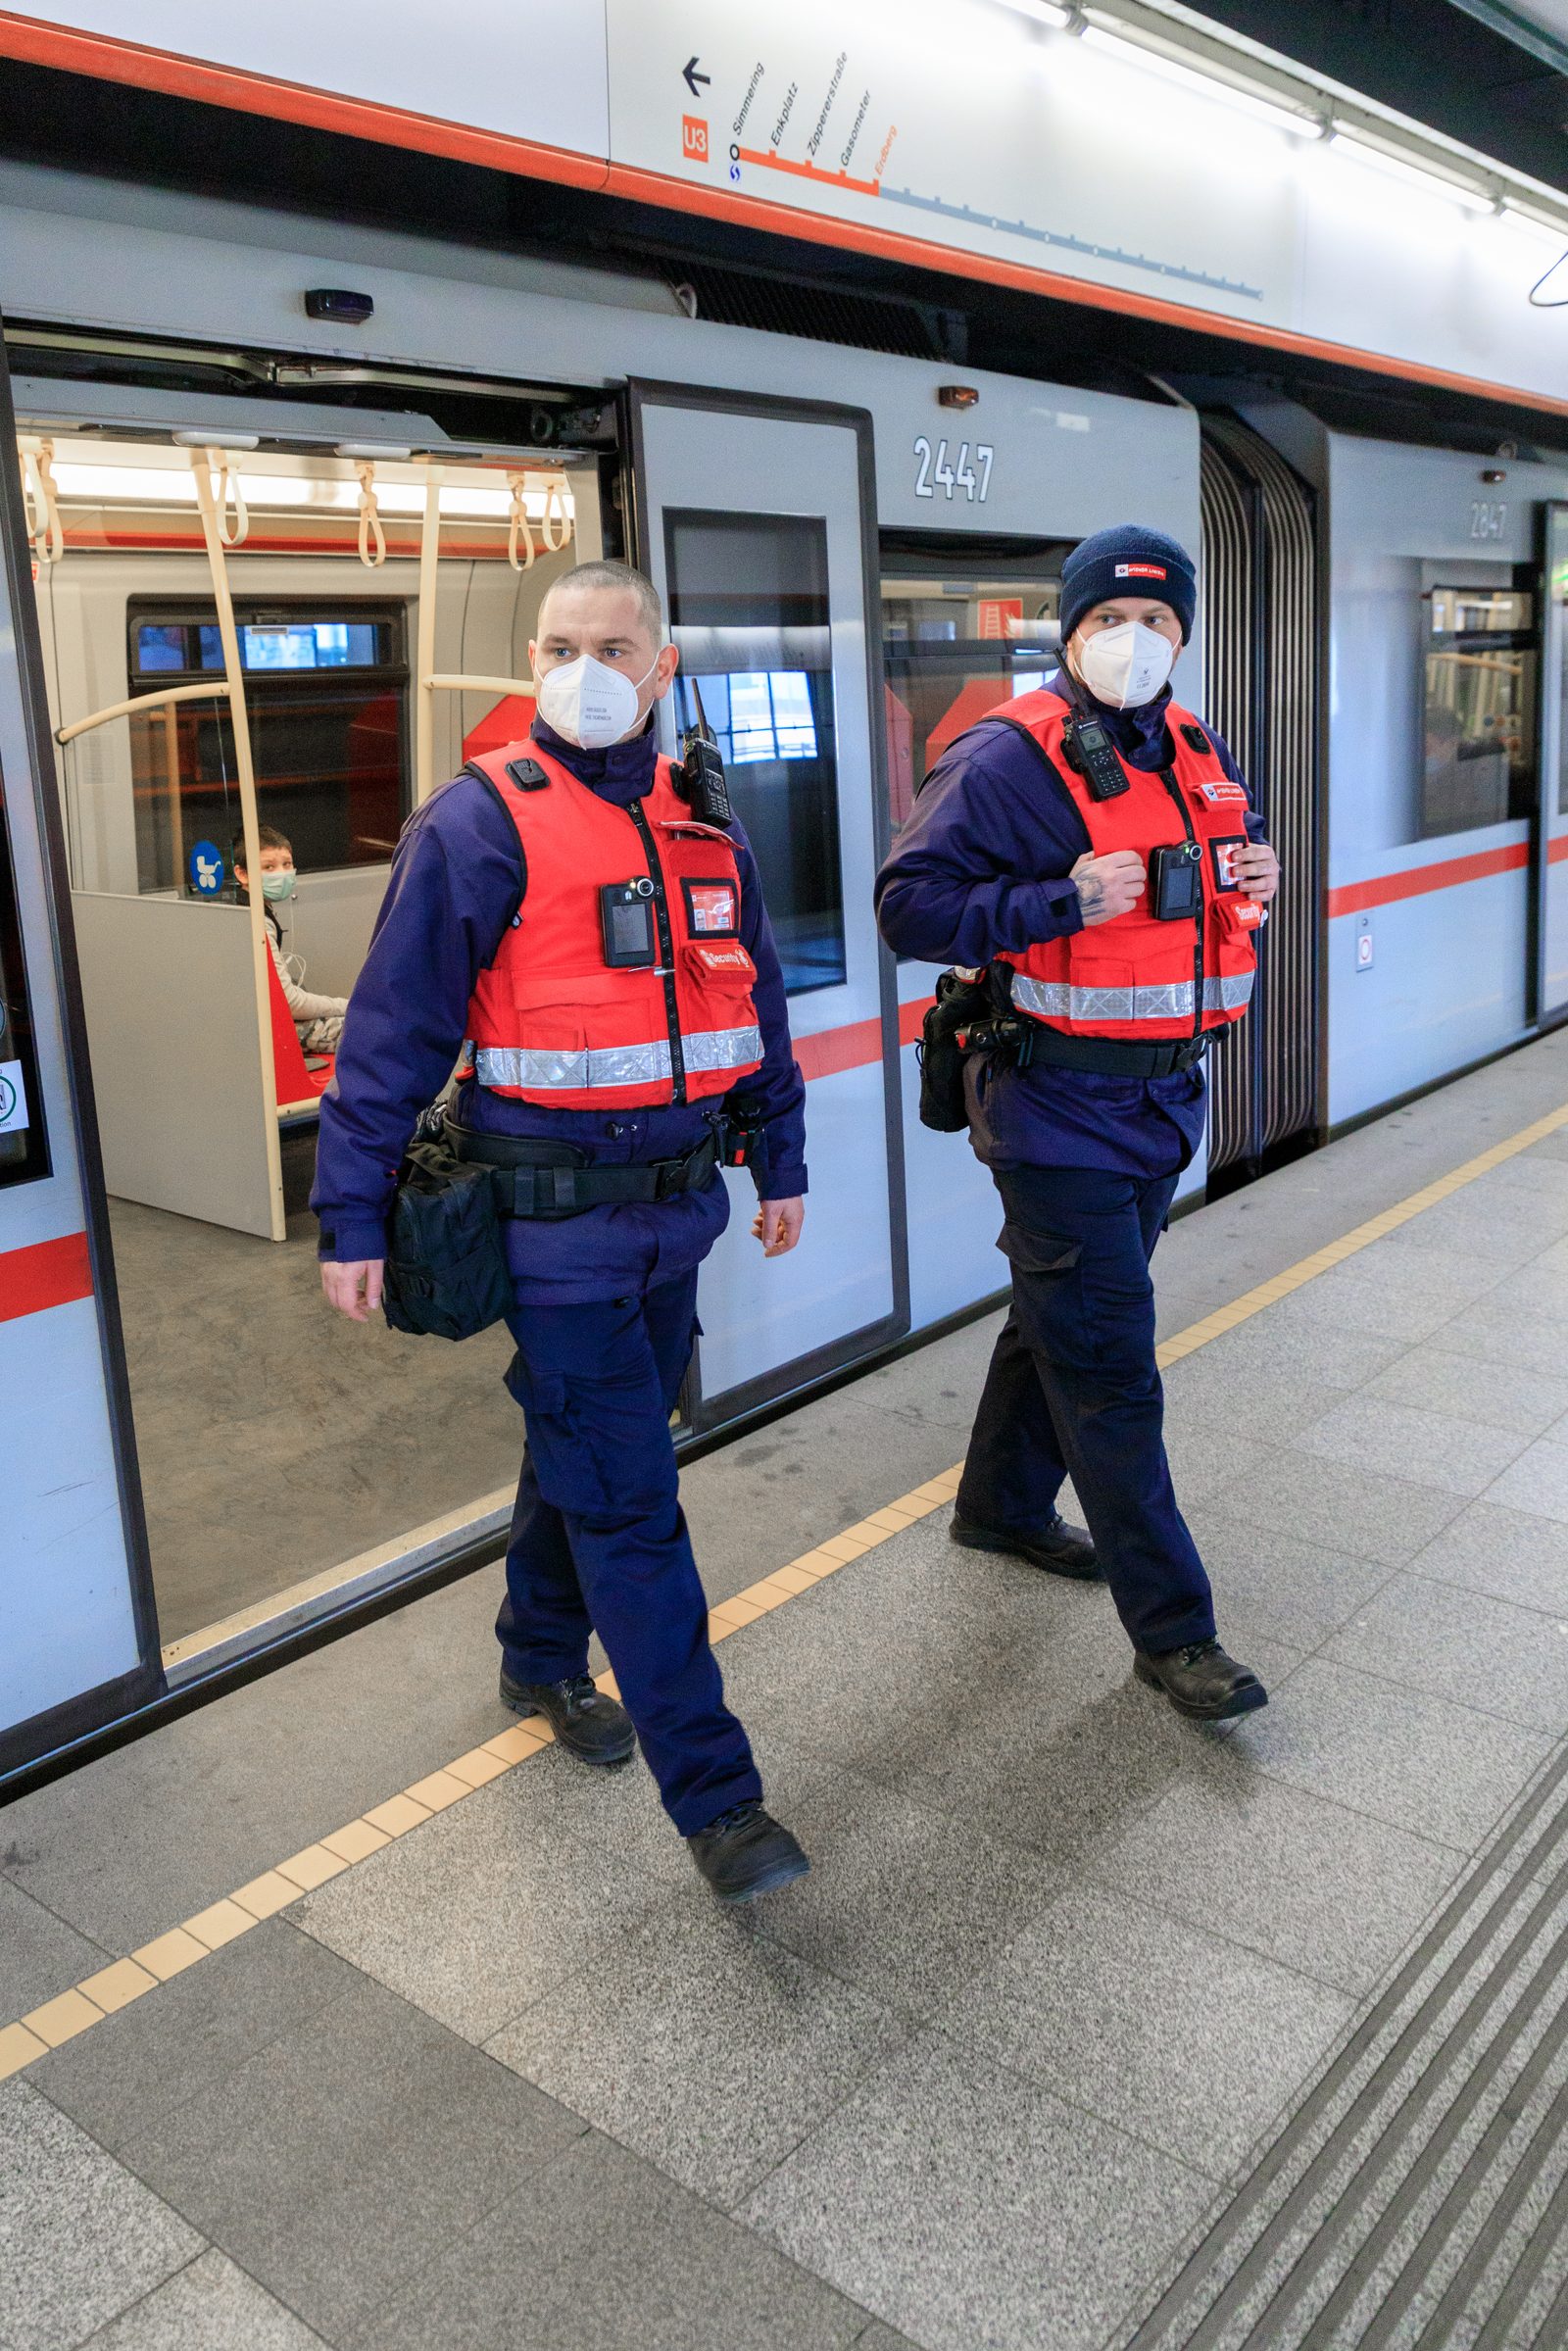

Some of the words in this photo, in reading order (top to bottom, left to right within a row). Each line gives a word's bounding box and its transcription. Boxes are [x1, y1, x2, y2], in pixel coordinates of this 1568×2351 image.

[733, 62, 764, 136] Simmering
[770, 82, 799, 146] Enkplatz
[807, 52, 848, 156] Zippererstraße
[841, 89, 871, 167] Gasometer
[684, 124, 707, 153] U3
[874, 124, 898, 174] Erdberg
[913, 435, 994, 503] 2447
[1235, 903, 1261, 921] Security
[710, 953, 740, 964] Security
